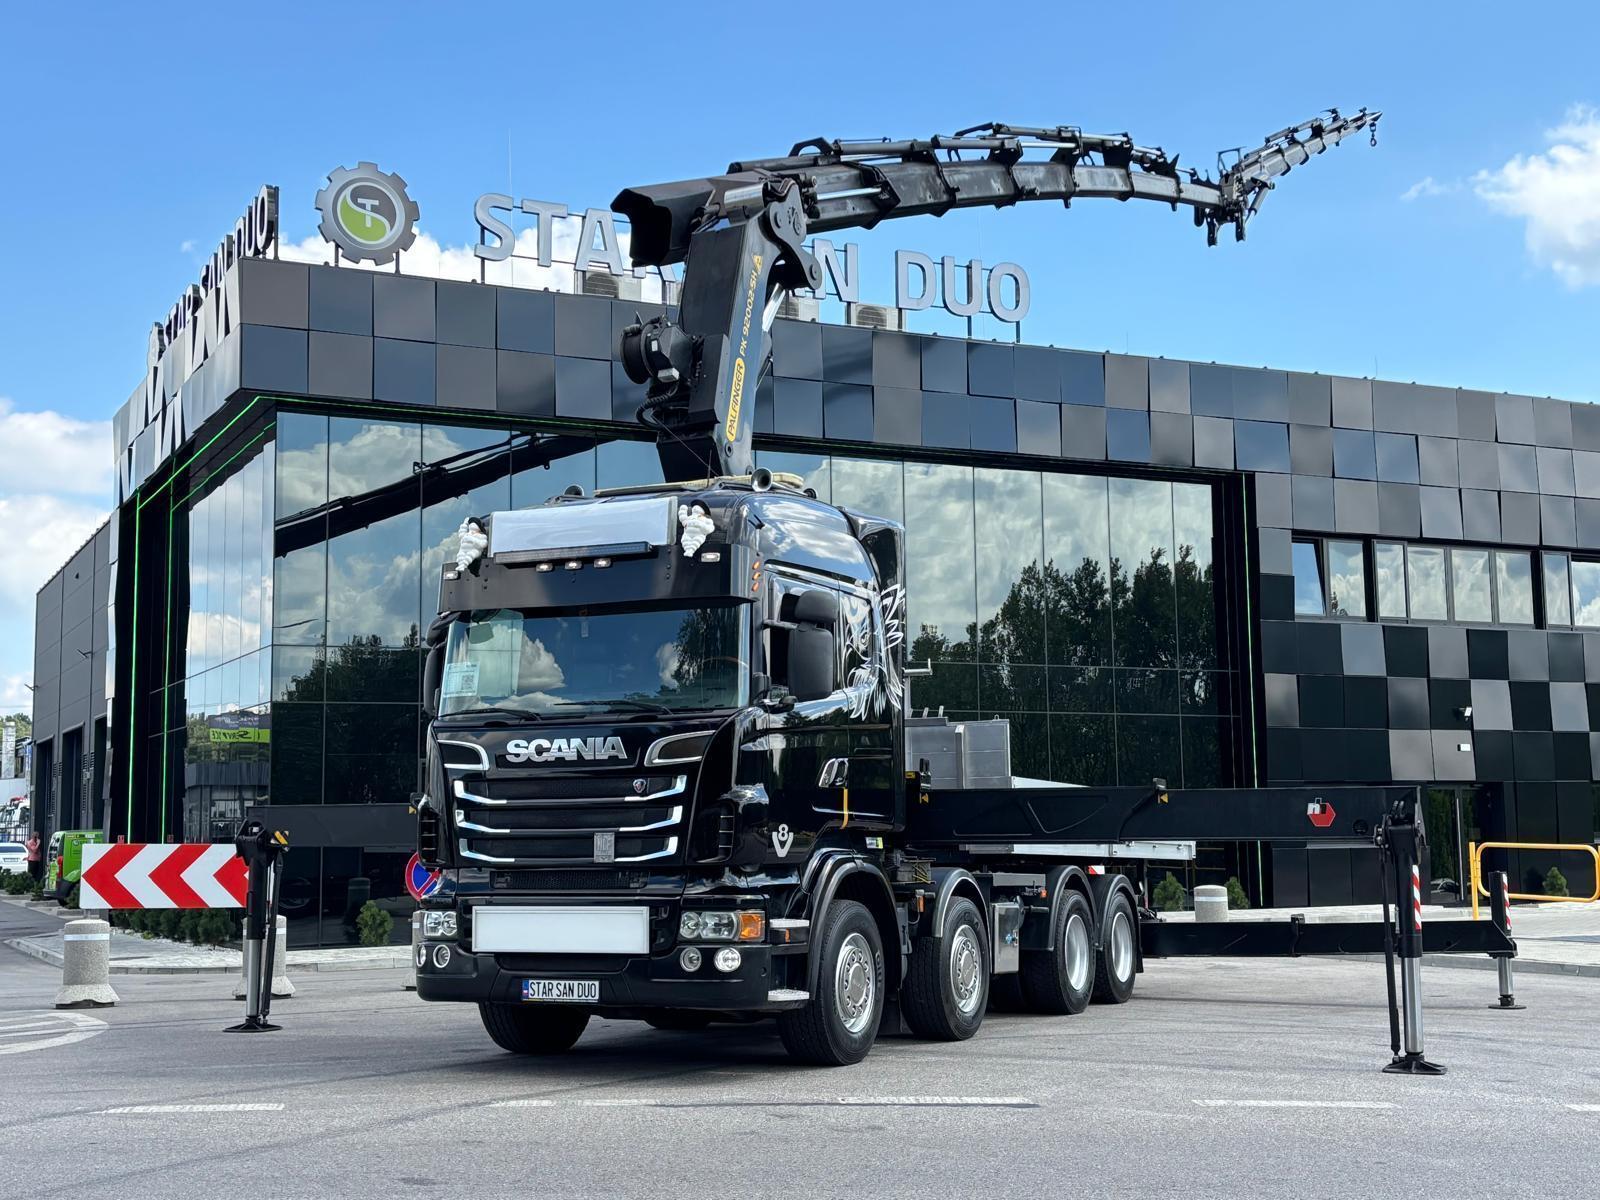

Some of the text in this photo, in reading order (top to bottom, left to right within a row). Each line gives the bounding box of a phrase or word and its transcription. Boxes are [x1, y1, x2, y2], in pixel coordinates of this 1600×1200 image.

[234, 184, 275, 258] DUO
[474, 193, 677, 283] STA
[895, 249, 1031, 324] DUO
[728, 270, 759, 438] PALFINGER PK 92002-SH
[505, 736, 628, 763] SCANIA
[529, 981, 597, 998] STAR SAN DUO
